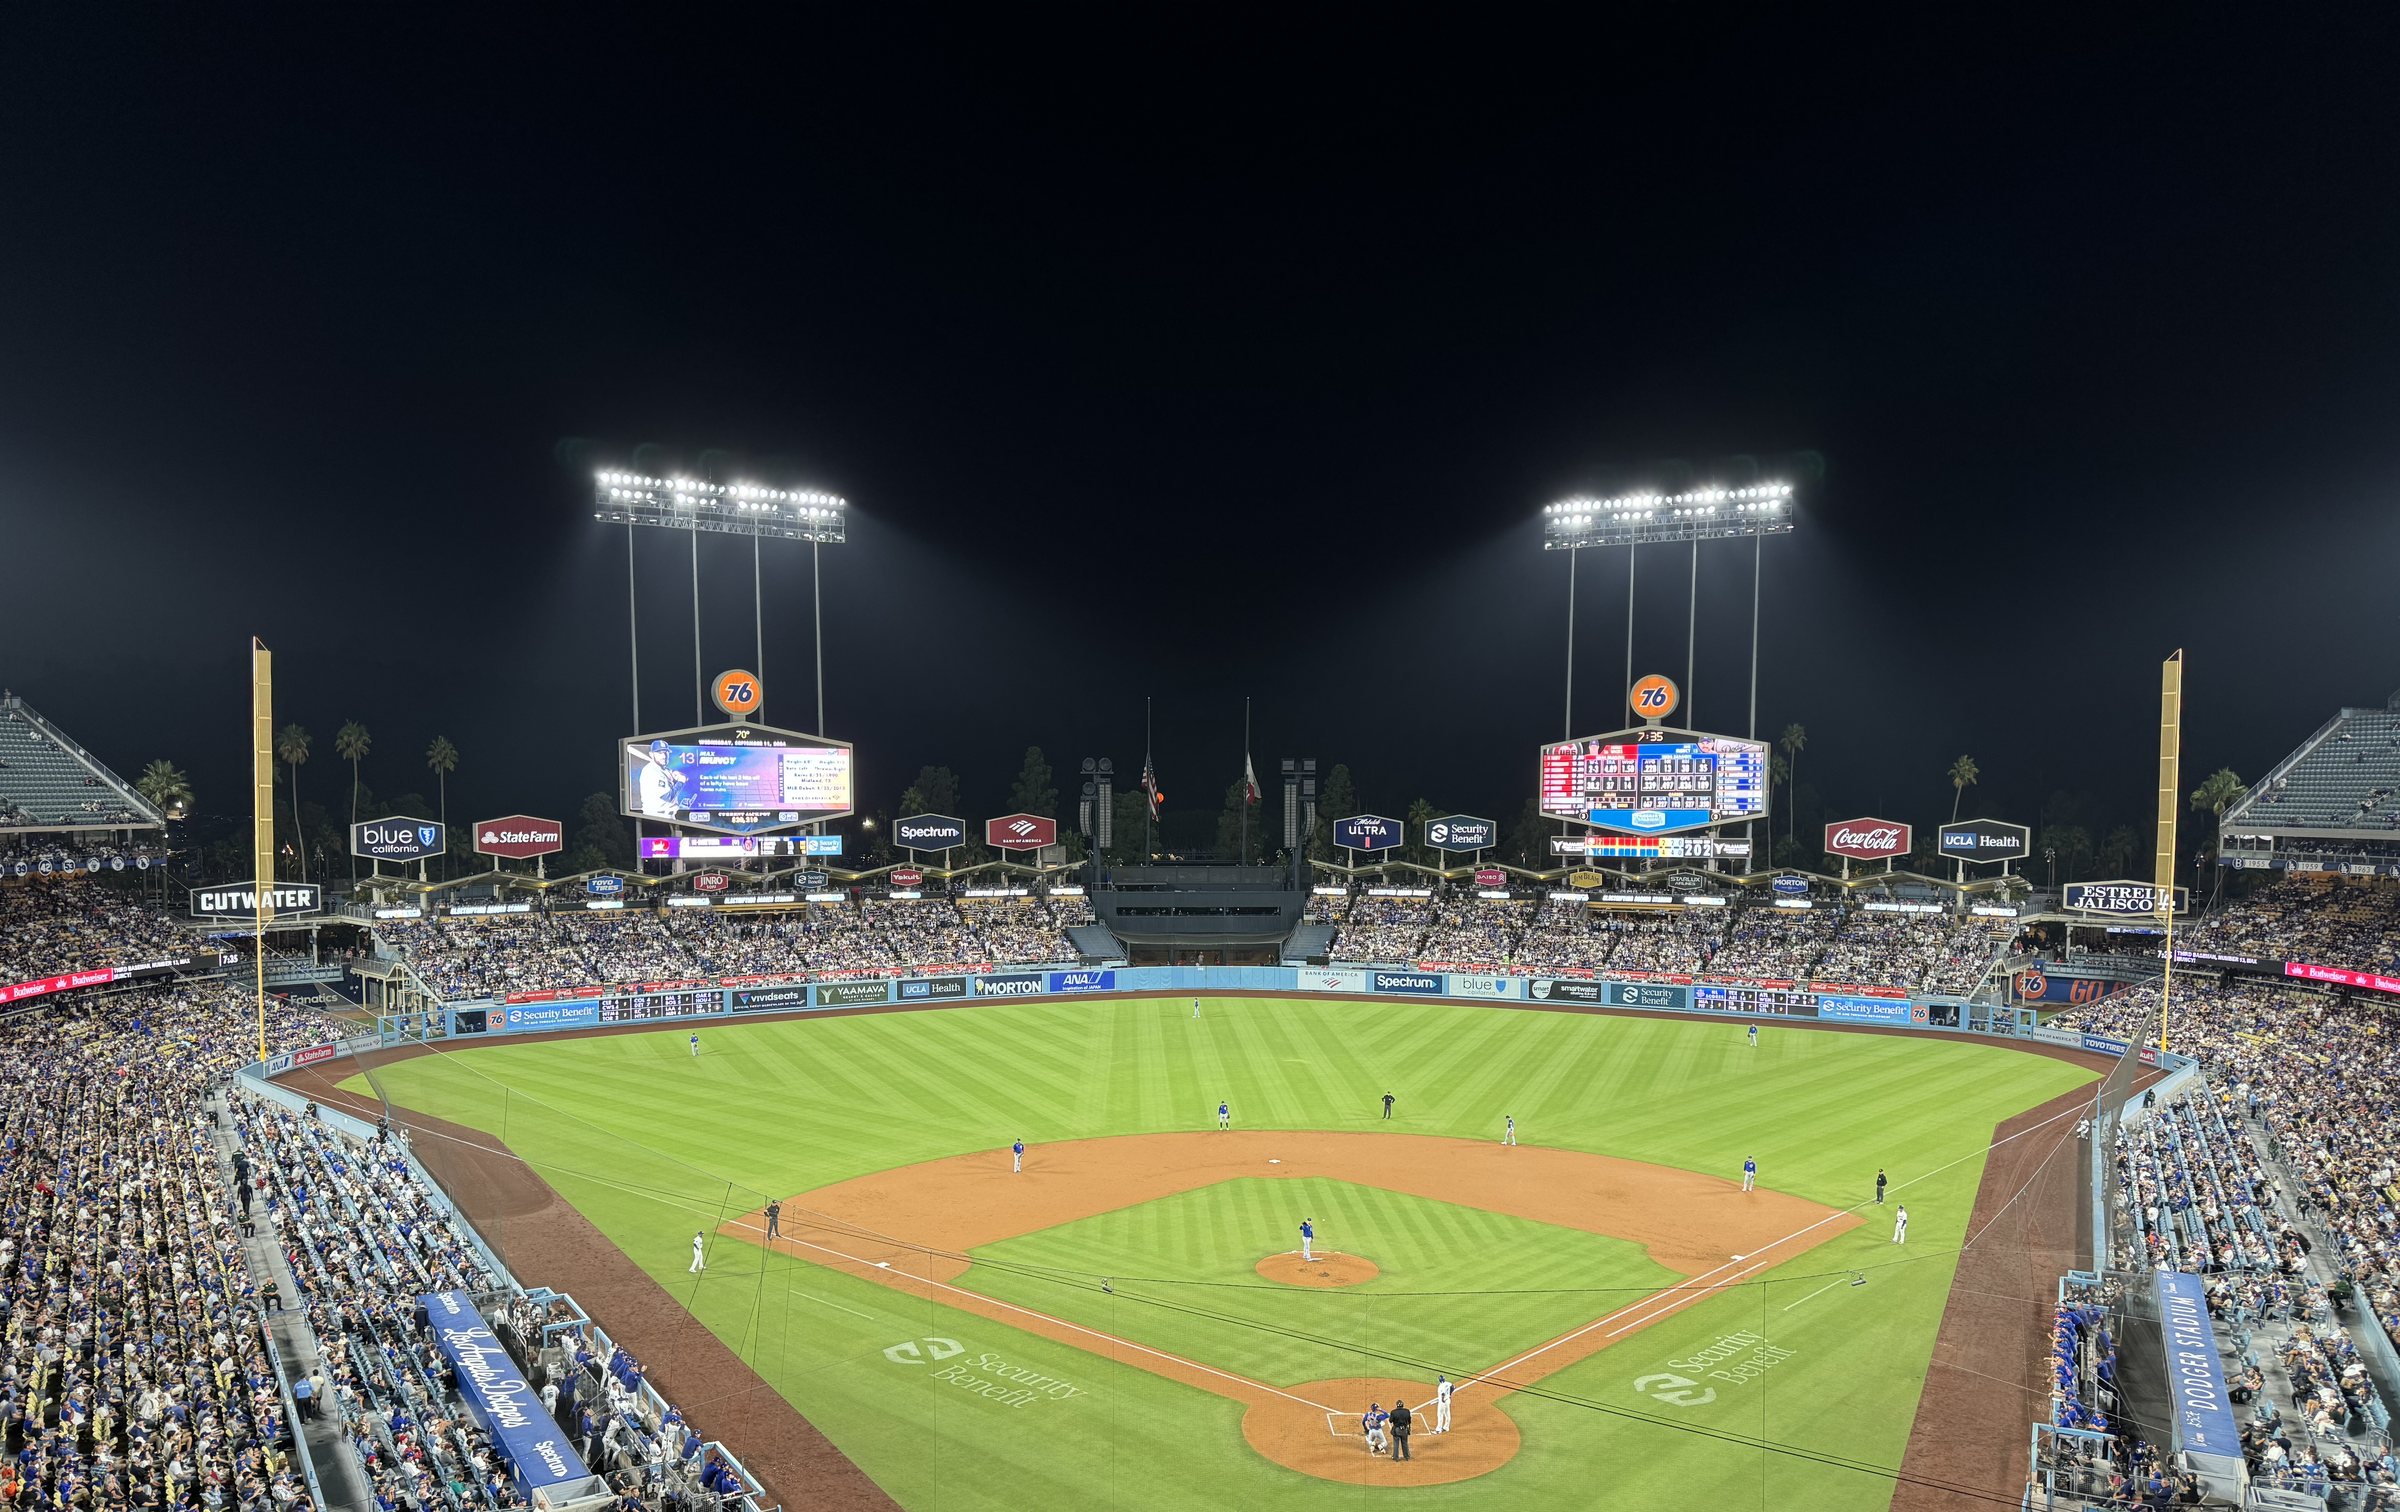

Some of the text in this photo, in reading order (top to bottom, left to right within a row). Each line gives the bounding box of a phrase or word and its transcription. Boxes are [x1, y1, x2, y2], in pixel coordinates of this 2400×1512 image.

[726, 682, 753, 703] 76
[1641, 684, 1669, 706] 76
[736, 730, 750, 739] 70°
[1638, 732, 1664, 742] 7:35
[679, 752, 695, 764] 13
[364, 826, 413, 844] blue
[901, 826, 956, 840] Spectrum
[1349, 826, 1387, 835] ULTRA
[1451, 824, 1488, 836] Security
[1451, 834, 1484, 843] Benefit
[1832, 828, 1901, 850] Coca-Cola
[1945, 836, 2020, 847] UCLA Health
[372, 845, 419, 853] california
[1685, 844, 1710, 856] 2 0 2
[40, 862, 52, 871] 42
[64, 862, 73, 870] 53
[700, 876, 723, 888] JINRO
[1572, 872, 1600, 885] JIM BEAM
[200, 889, 311, 911] CUTWATER
[2074, 897, 2153, 911] JALISCO
[222, 954, 238, 964] 7:35
[72, 972, 109, 986] Budweiser
[1063, 974, 1088, 985] ANA
[2309, 967, 2347, 982] Budweiser
[906, 983, 961, 994] UCLA Health
[985, 980, 1042, 994] MORTON
[1377, 975, 1433, 989] Spectrum
[1463, 977, 1491, 990] blue
[2019, 975, 2043, 993] 76
[13, 983, 46, 998] Budweiser
[1467, 989, 1496, 997] california
[1641, 988, 1673, 998] Security
[290, 993, 338, 1005] Fanatics
[751, 992, 798, 1003] vividseats
[1641, 996, 1669, 1006] Benefit
[523, 1007, 593, 1020] Security Benefit
[1836, 1003, 1904, 1015] Security Benefit
[1913, 1009, 1926, 1019] 76
[490, 1014, 504, 1025] 76
[2085, 1039, 2126, 1053] TOYO TIRES
[271, 1061, 284, 1072] ANA
[436, 1291, 460, 1314] Spectrum
[2169, 1296, 2206, 1348] STADIUM
[1667, 1329, 1769, 1373] Security
[459, 1346, 504, 1390] Angeles
[1707, 1346, 1797, 1385] Benefit
[965, 1353, 1088, 1400] Security
[2179, 1351, 2218, 1411] DODGER
[929, 1364, 1040, 1409] Benefit
[480, 1379, 531, 1429] Dodgers
[535, 1440, 568, 1477] Spectrum
